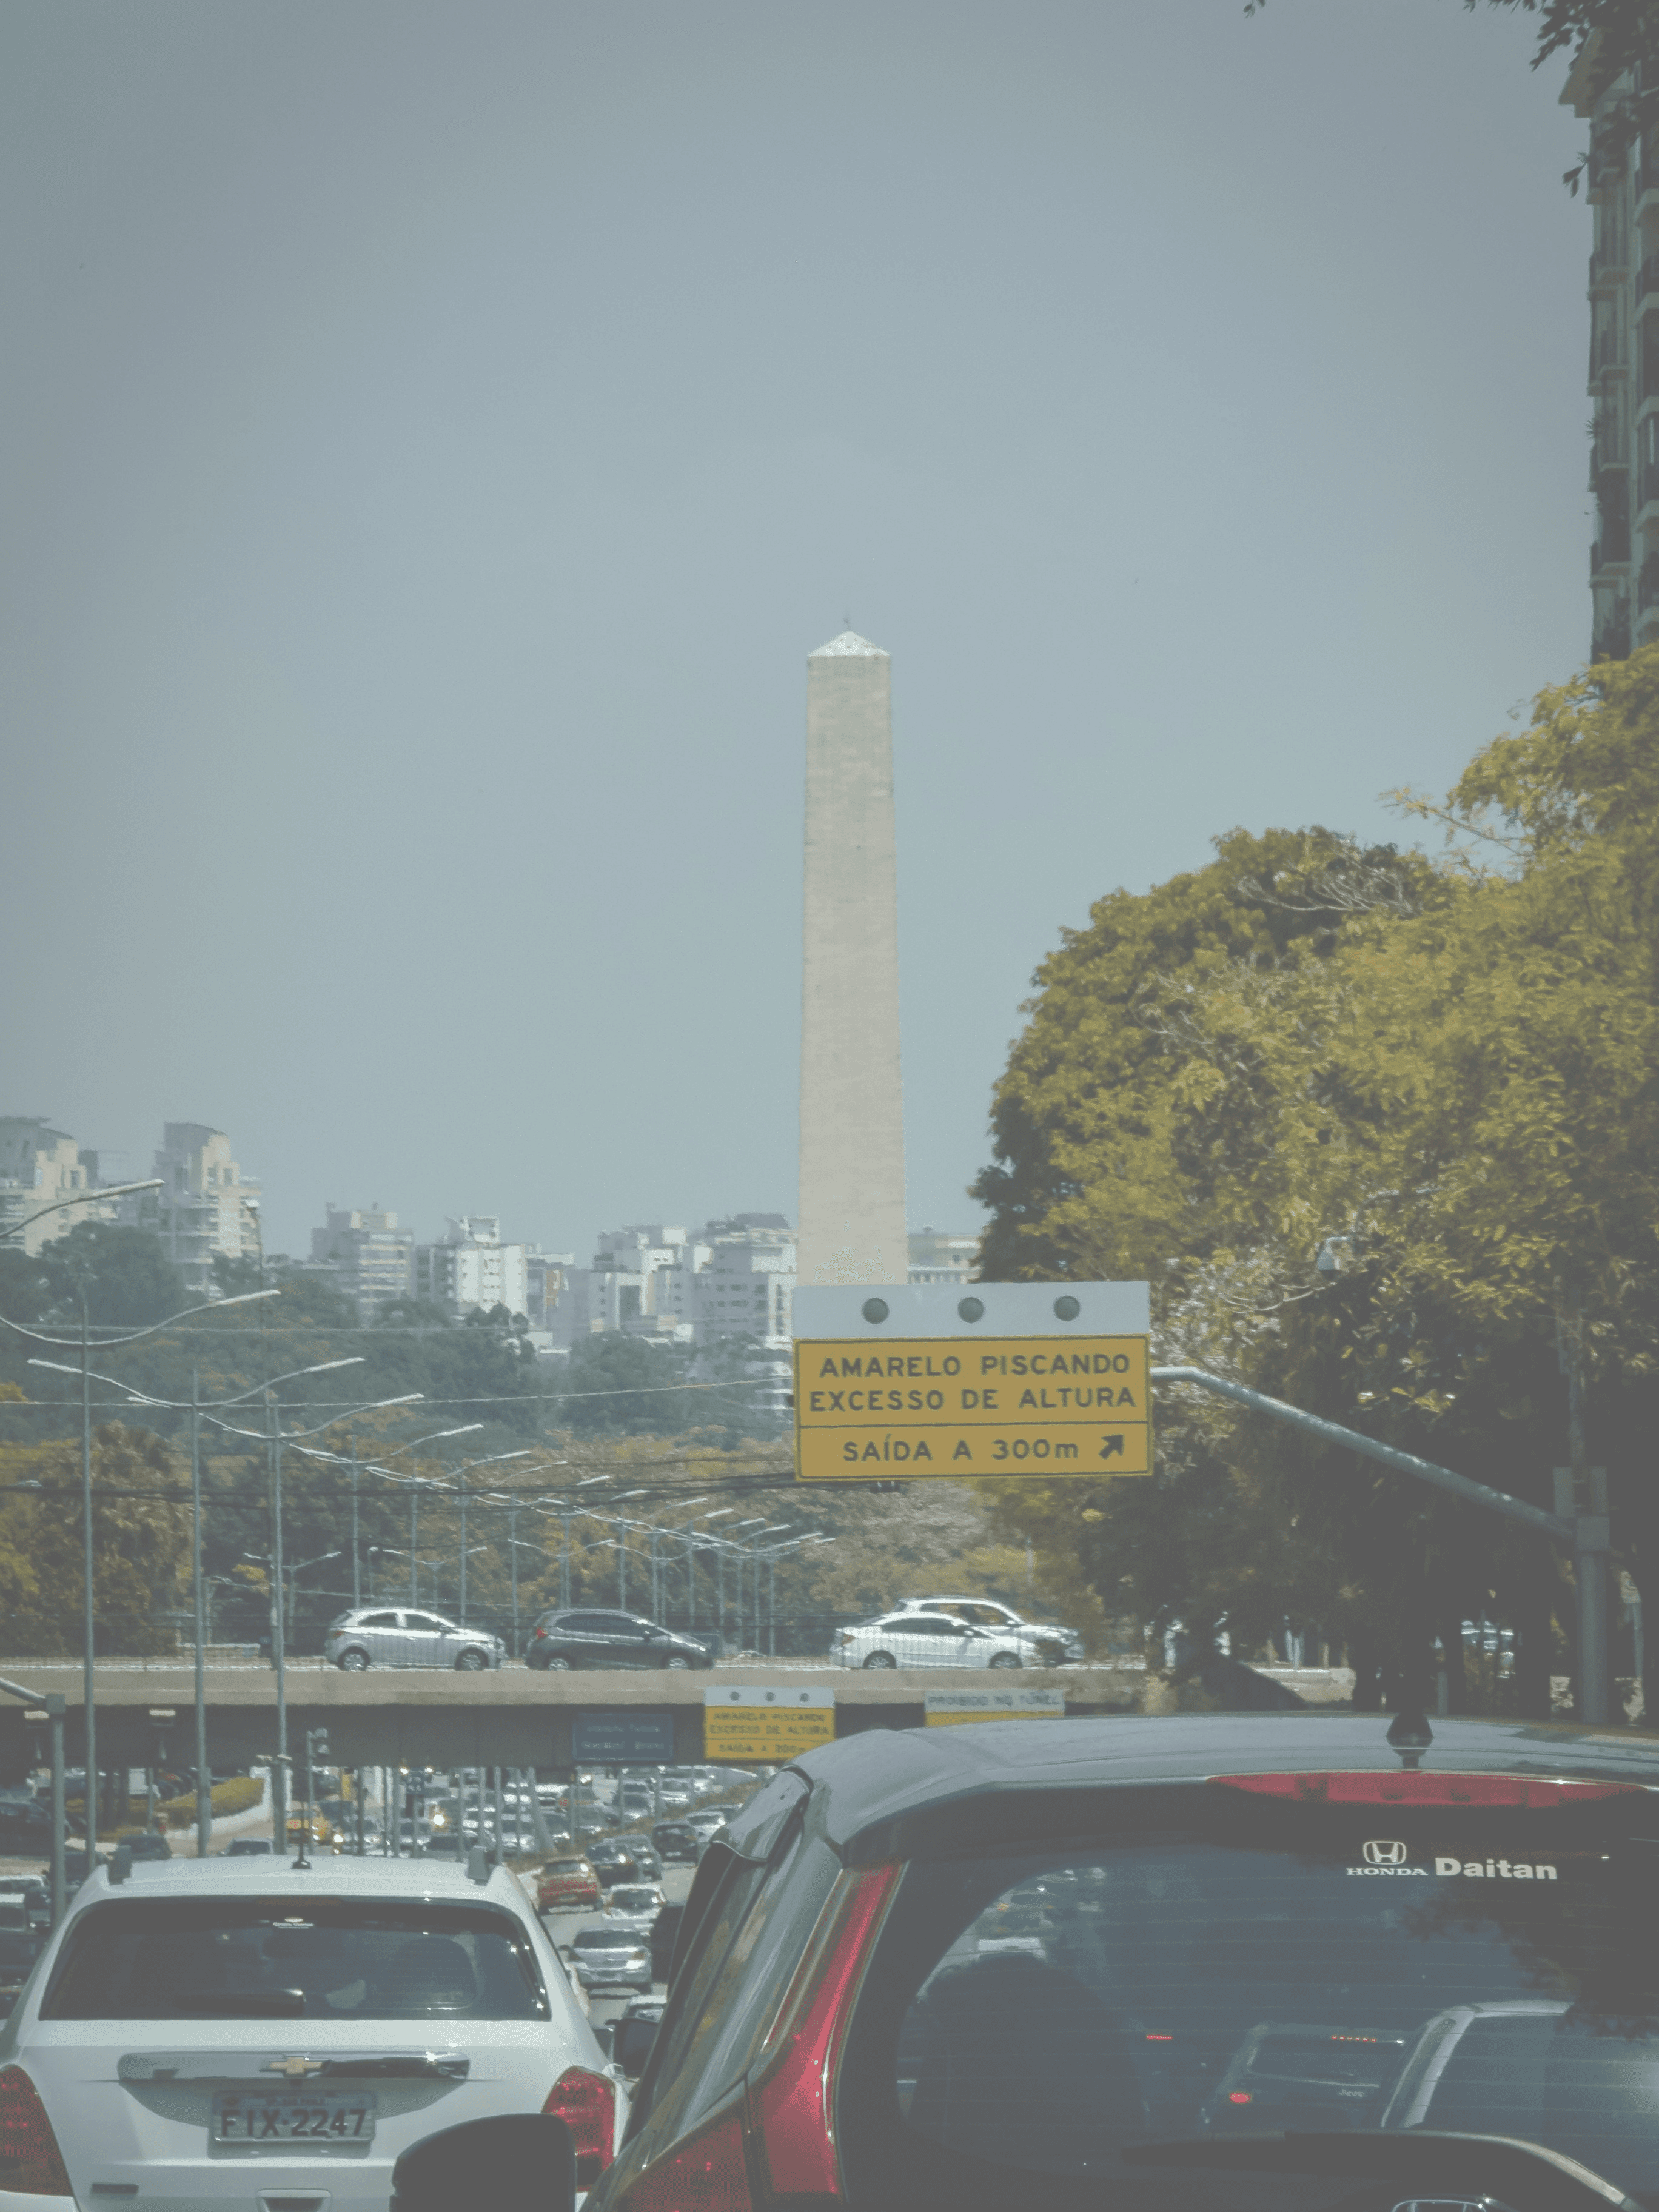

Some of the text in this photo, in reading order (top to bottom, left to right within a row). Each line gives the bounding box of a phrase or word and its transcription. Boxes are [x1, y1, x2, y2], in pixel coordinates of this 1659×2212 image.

[820, 1353, 1130, 1378] AMARELO PISCANDO
[810, 1387, 1136, 1412] EXCESSO DE ALTURA
[843, 1434, 1078, 1461] SAÍDA A 300m
[714, 1712, 766, 1721] AMARELO
[765, 1725, 780, 1734] DE
[787, 1726, 830, 1734] ALTURA
[1346, 1868, 1428, 1876] HONDA
[1435, 1857, 1557, 1880] Daitan
